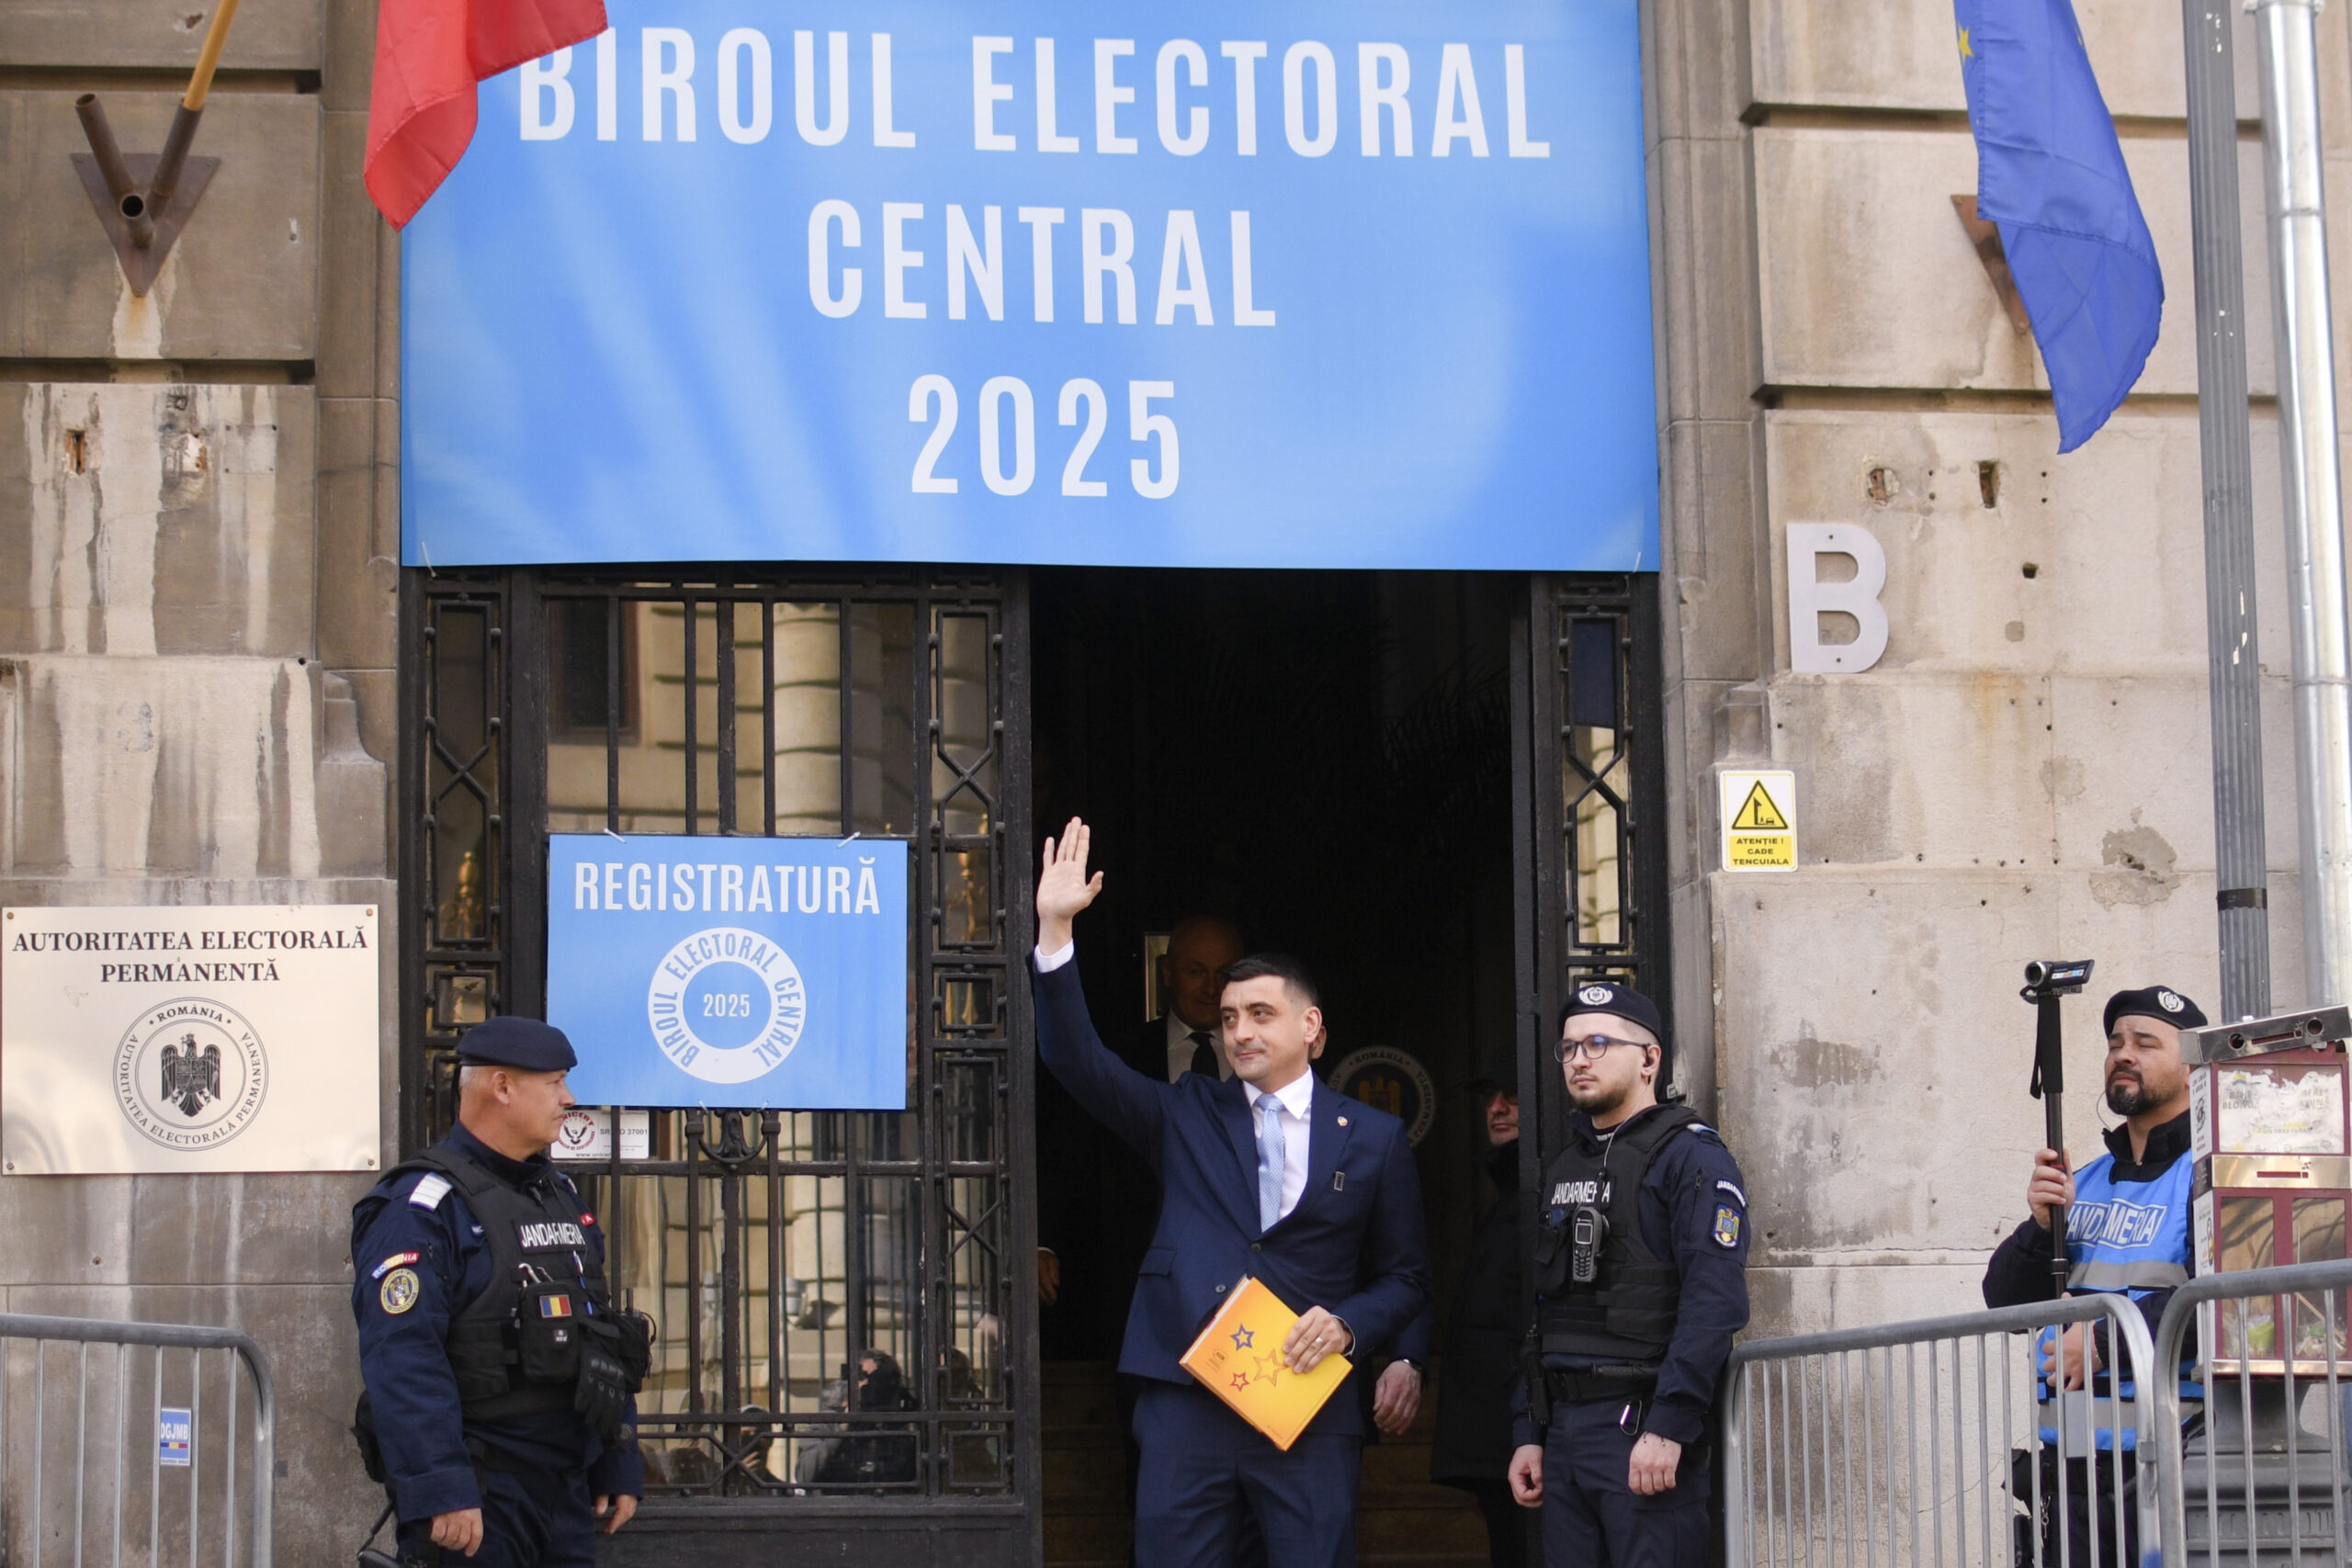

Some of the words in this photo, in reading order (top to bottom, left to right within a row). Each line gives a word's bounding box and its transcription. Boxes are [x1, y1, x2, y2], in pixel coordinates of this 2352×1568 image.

[520, 27, 916, 148] BIROUL
[972, 36, 1551, 159] ELECTORAL
[808, 199, 1276, 326] CENTRAL
[909, 374, 1181, 499] 2025
[1786, 523, 1889, 673] B
[575, 857, 880, 914] REGISTRATURĂ
[13, 931, 194, 952] AUTORITATEA
[201, 926, 368, 950] ELECTORALĂ
[101, 958, 280, 983] PERMANENTĂ
[664, 933, 778, 980] ELECTORAL
[653, 992, 700, 1067] BIROUL
[703, 993, 751, 1018] 2025
[752, 976, 801, 1067] CENTRAL
[120, 1034, 149, 1127] AUTORITATEA
[561, 1111, 595, 1127] NICERT
[2065, 1202, 2159, 1244] ANDMERIA
